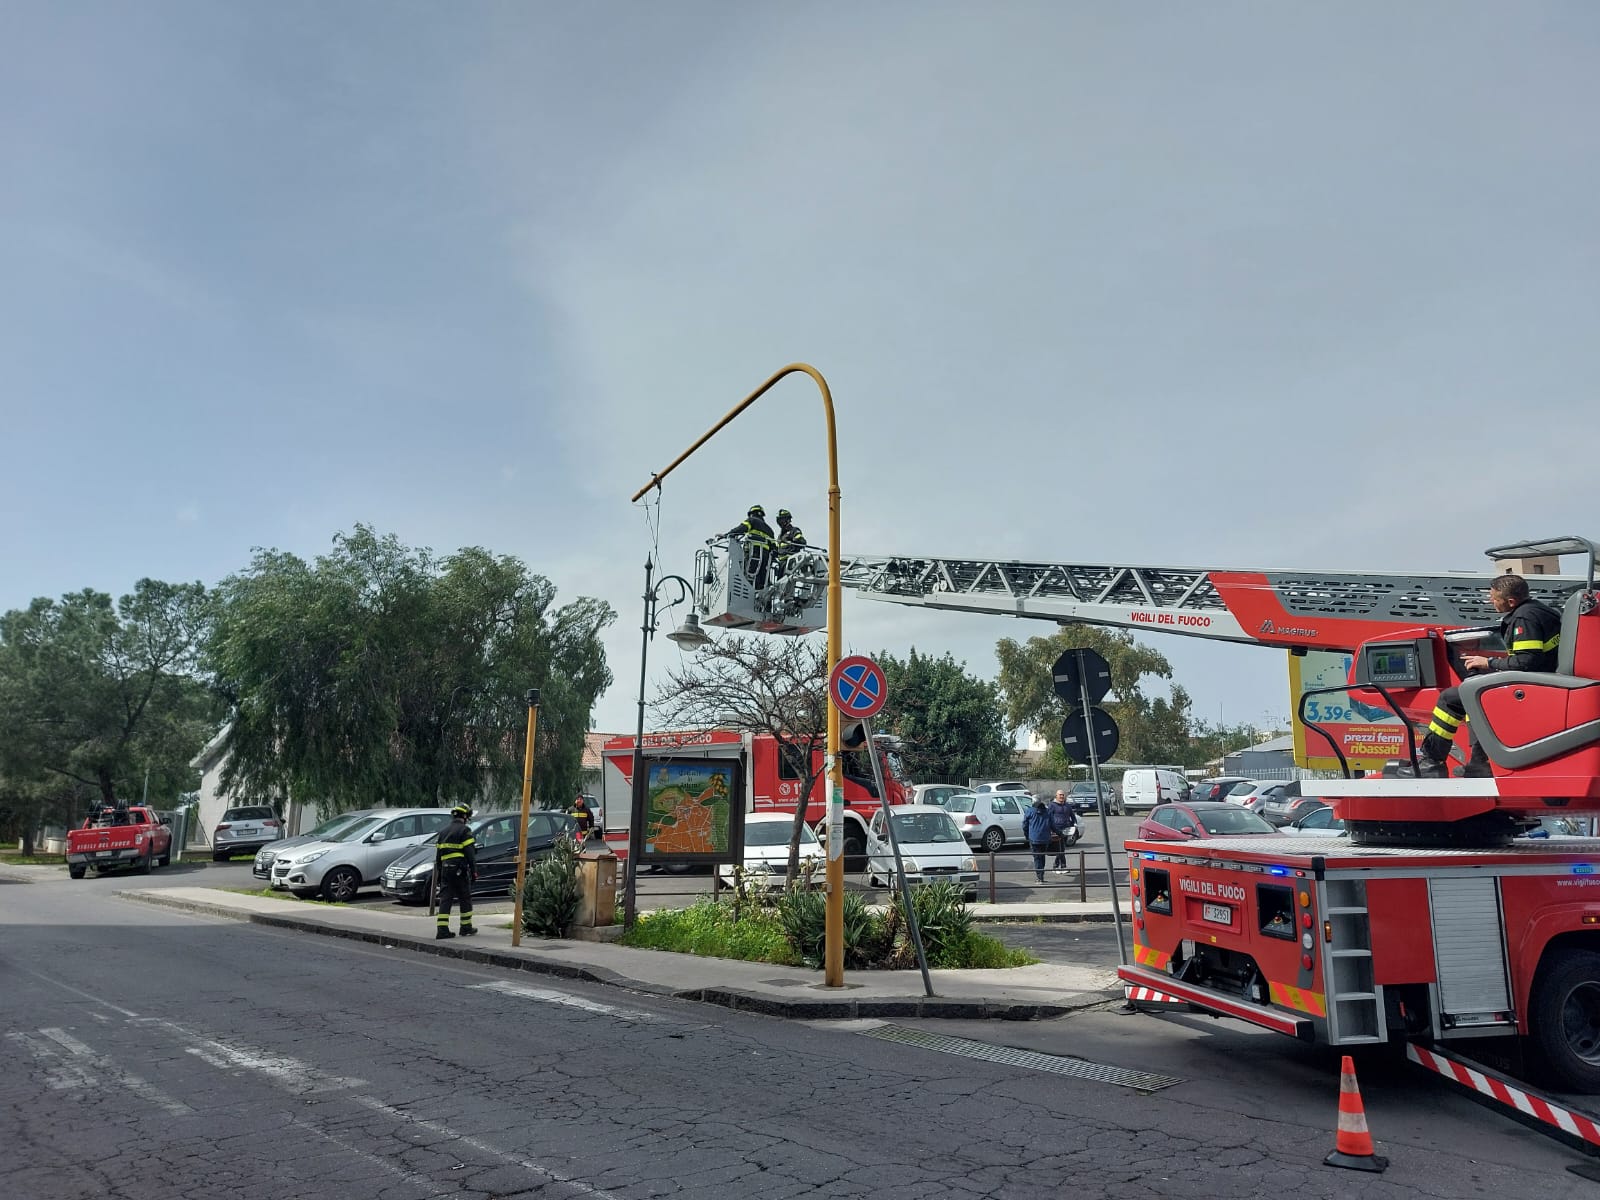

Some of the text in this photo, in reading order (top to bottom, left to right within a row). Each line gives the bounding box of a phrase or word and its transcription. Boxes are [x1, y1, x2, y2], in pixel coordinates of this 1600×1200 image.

[1131, 612, 1211, 627] VIGILI DEL FUOCO
[1307, 702, 1352, 722] 3,39€
[1344, 732, 1376, 744] prezzi
[1377, 732, 1405, 743] fermi
[1350, 742, 1400, 754] ribassati
[1179, 878, 1246, 901] VIGILI DEL FUOCO
